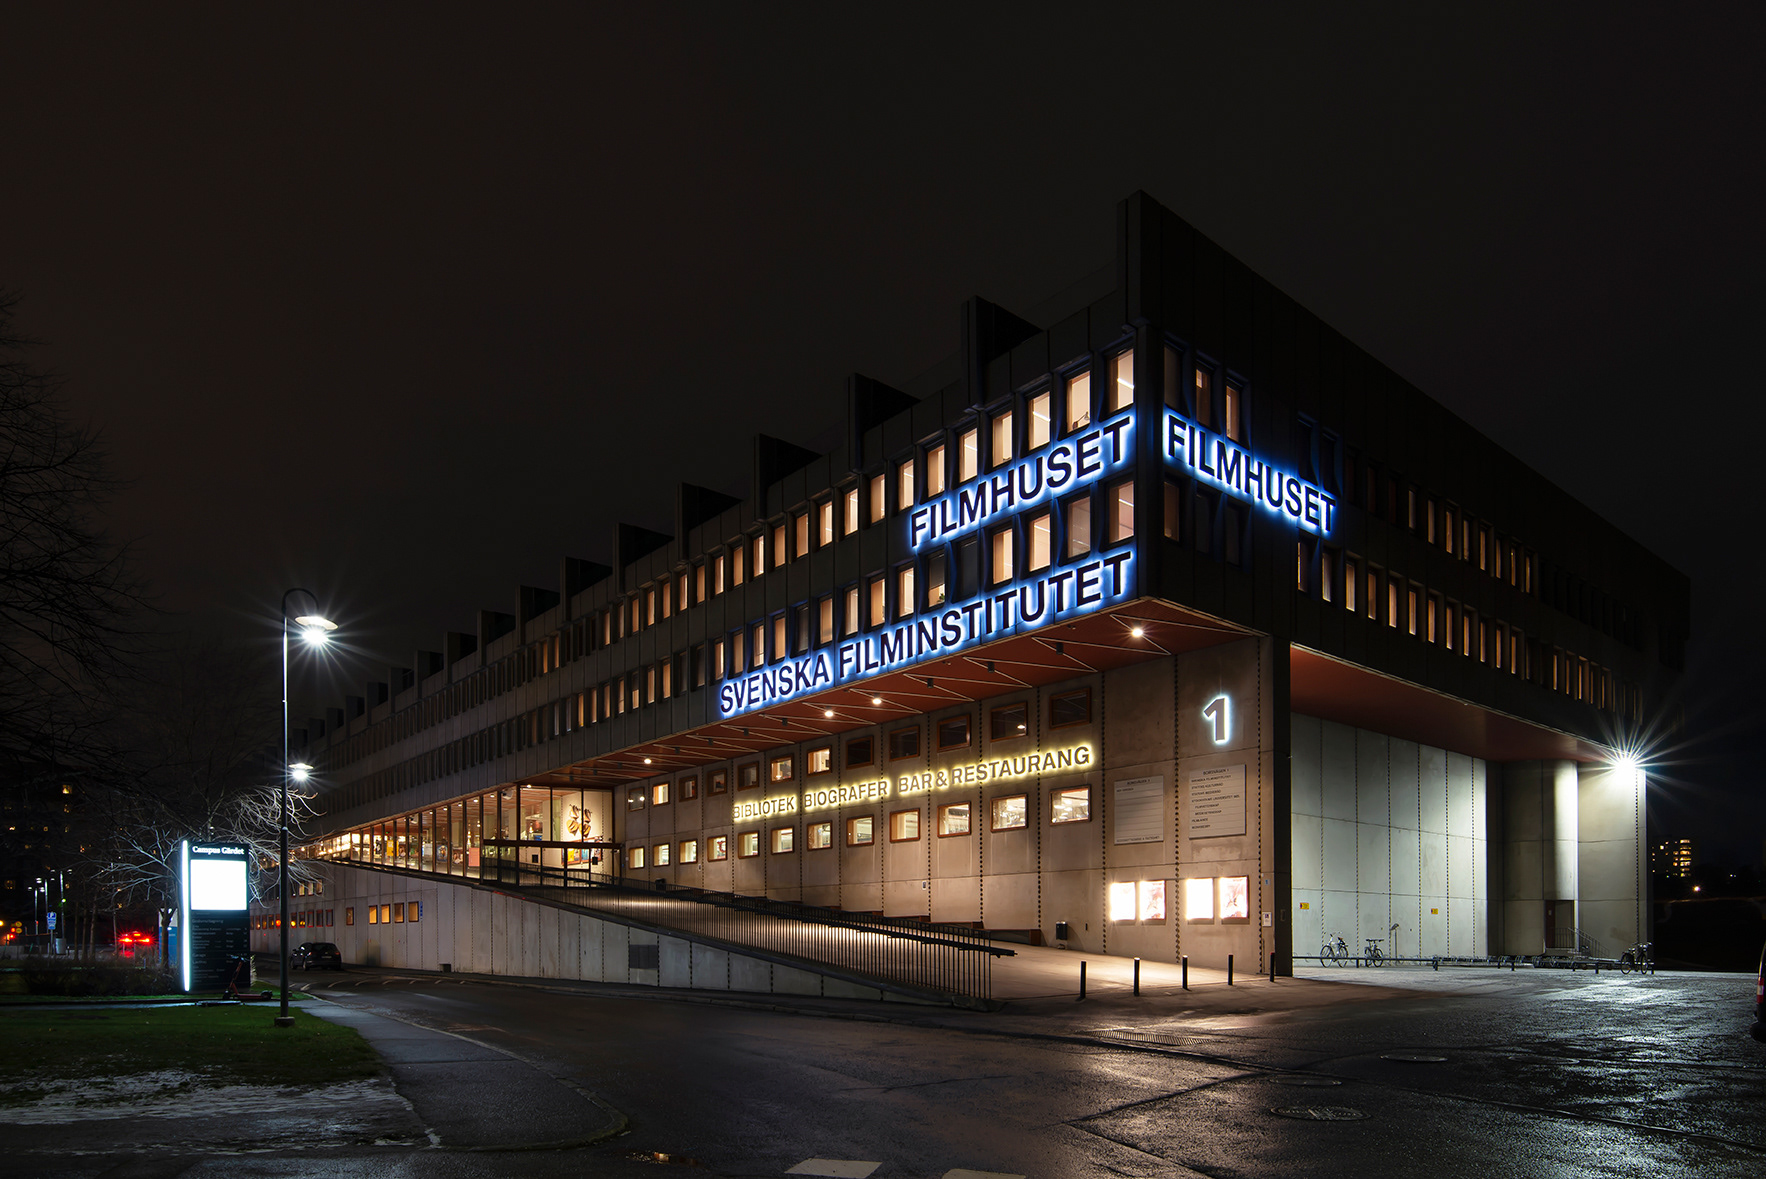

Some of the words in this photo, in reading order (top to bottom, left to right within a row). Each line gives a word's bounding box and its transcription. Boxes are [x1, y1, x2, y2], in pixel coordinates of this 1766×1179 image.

[911, 416, 1131, 548] FILMHUSET
[1168, 414, 1336, 532] FILMHUSET
[720, 653, 830, 713] SVENSKA
[839, 551, 1131, 679] FILMINSTITUTET
[1203, 697, 1227, 742] 1
[733, 796, 795, 819] BIBLIOTEK
[804, 780, 888, 808] BIOGRAFER
[899, 773, 932, 793] BAR
[951, 746, 1090, 785] RESTAURANG
[192, 846, 220, 855] Campus
